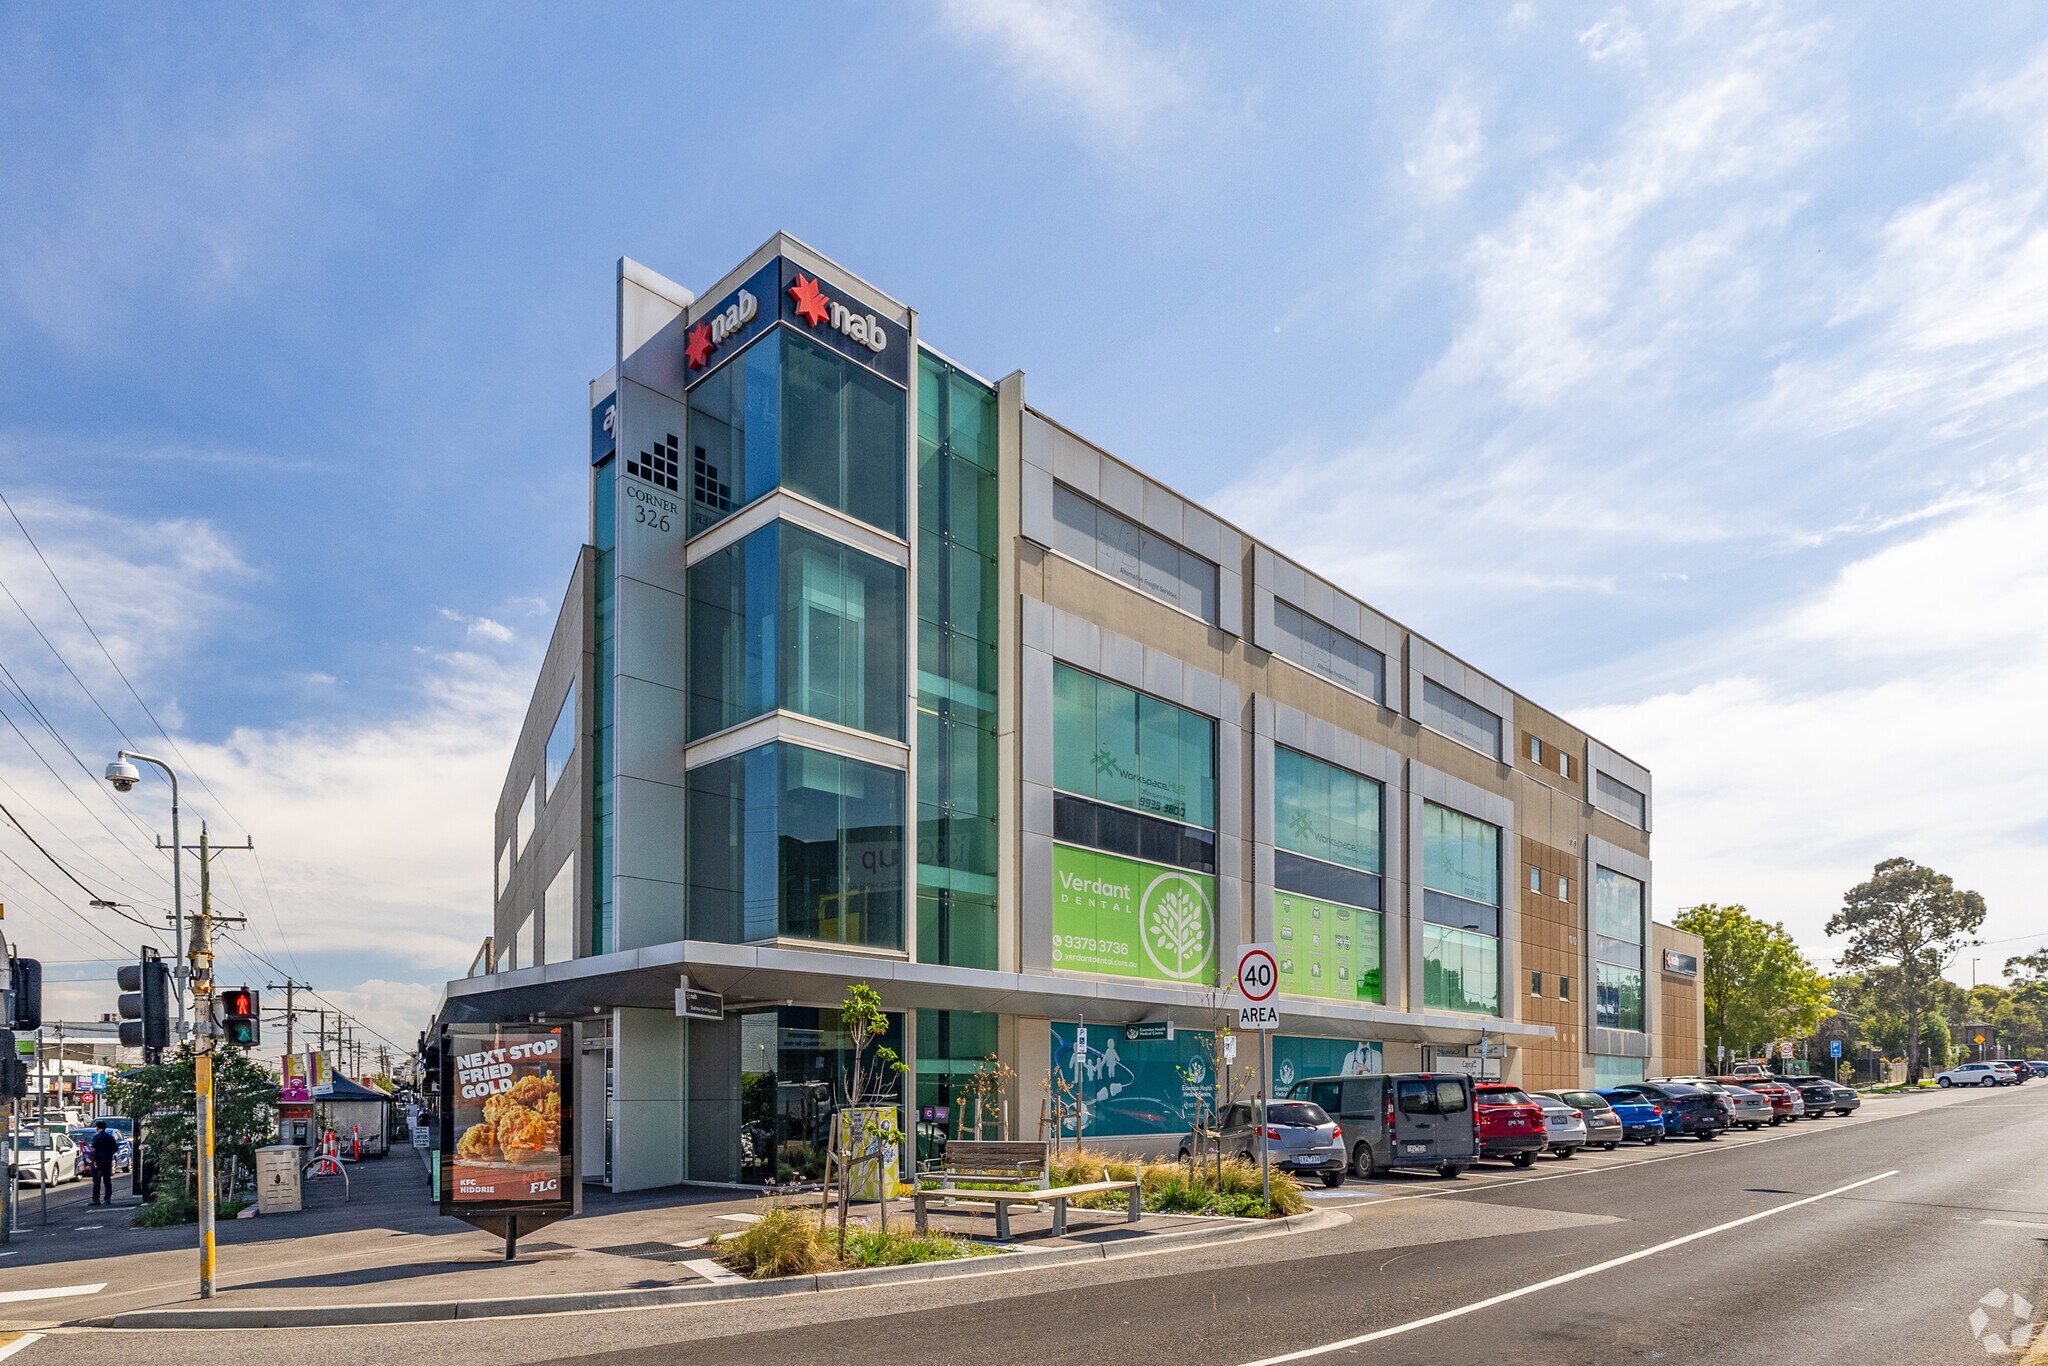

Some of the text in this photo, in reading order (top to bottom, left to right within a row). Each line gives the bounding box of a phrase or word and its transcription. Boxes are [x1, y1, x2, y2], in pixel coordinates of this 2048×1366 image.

[711, 289, 758, 343] nab
[830, 302, 887, 352] nab
[627, 486, 678, 515] CORNER
[635, 505, 671, 532] 326
[1119, 769, 1168, 791] Workspace
[1059, 870, 1131, 900] Verdant
[1061, 894, 1132, 913] DENTAL
[1064, 935, 1129, 955] 9379 3736
[1064, 954, 1137, 968] verdantdental.com.au
[1244, 964, 1271, 987] 40
[1240, 1007, 1278, 1022] AREA
[456, 1039, 558, 1070] NEXT STOP
[459, 1063, 513, 1085] FRIED
[461, 1078, 513, 1099] GOLD
[529, 1179, 557, 1194] FLG
